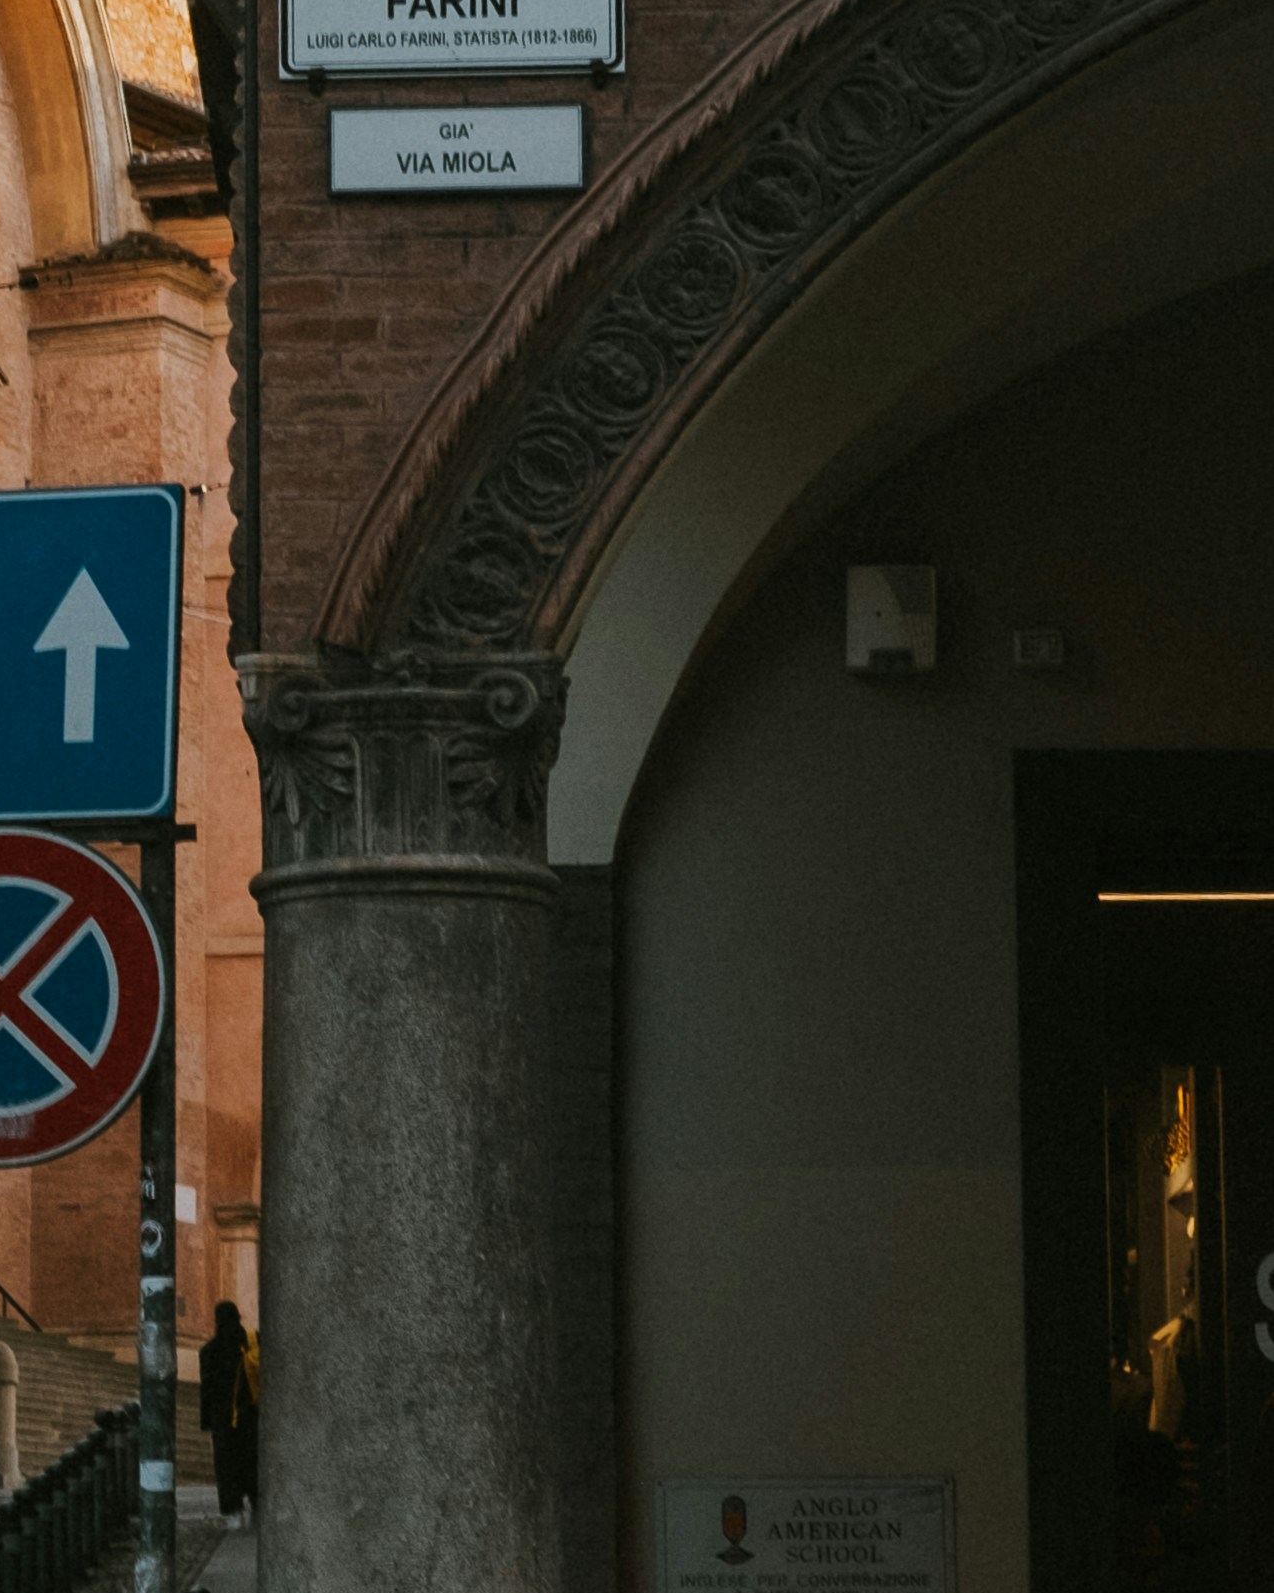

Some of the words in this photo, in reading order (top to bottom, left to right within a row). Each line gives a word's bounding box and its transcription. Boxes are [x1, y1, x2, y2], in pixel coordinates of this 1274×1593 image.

[307, 33, 344, 49] LUIGI
[347, 32, 396, 49] CARLO
[400, 31, 450, 49] FARINI,
[454, 29, 519, 47] STATISTA
[521, 27, 598, 49] (1812-1866)
[439, 123, 474, 140] GIA'
[397, 152, 434, 174] VIA
[442, 150, 517, 174] MIOLA
[792, 1498, 879, 1518] ANGLO
[767, 1521, 903, 1541] AMERICAN
[786, 1545, 884, 1565] SCHOOL
[680, 1573, 748, 1588] INGLESE
[757, 1573, 788, 1587] PER
